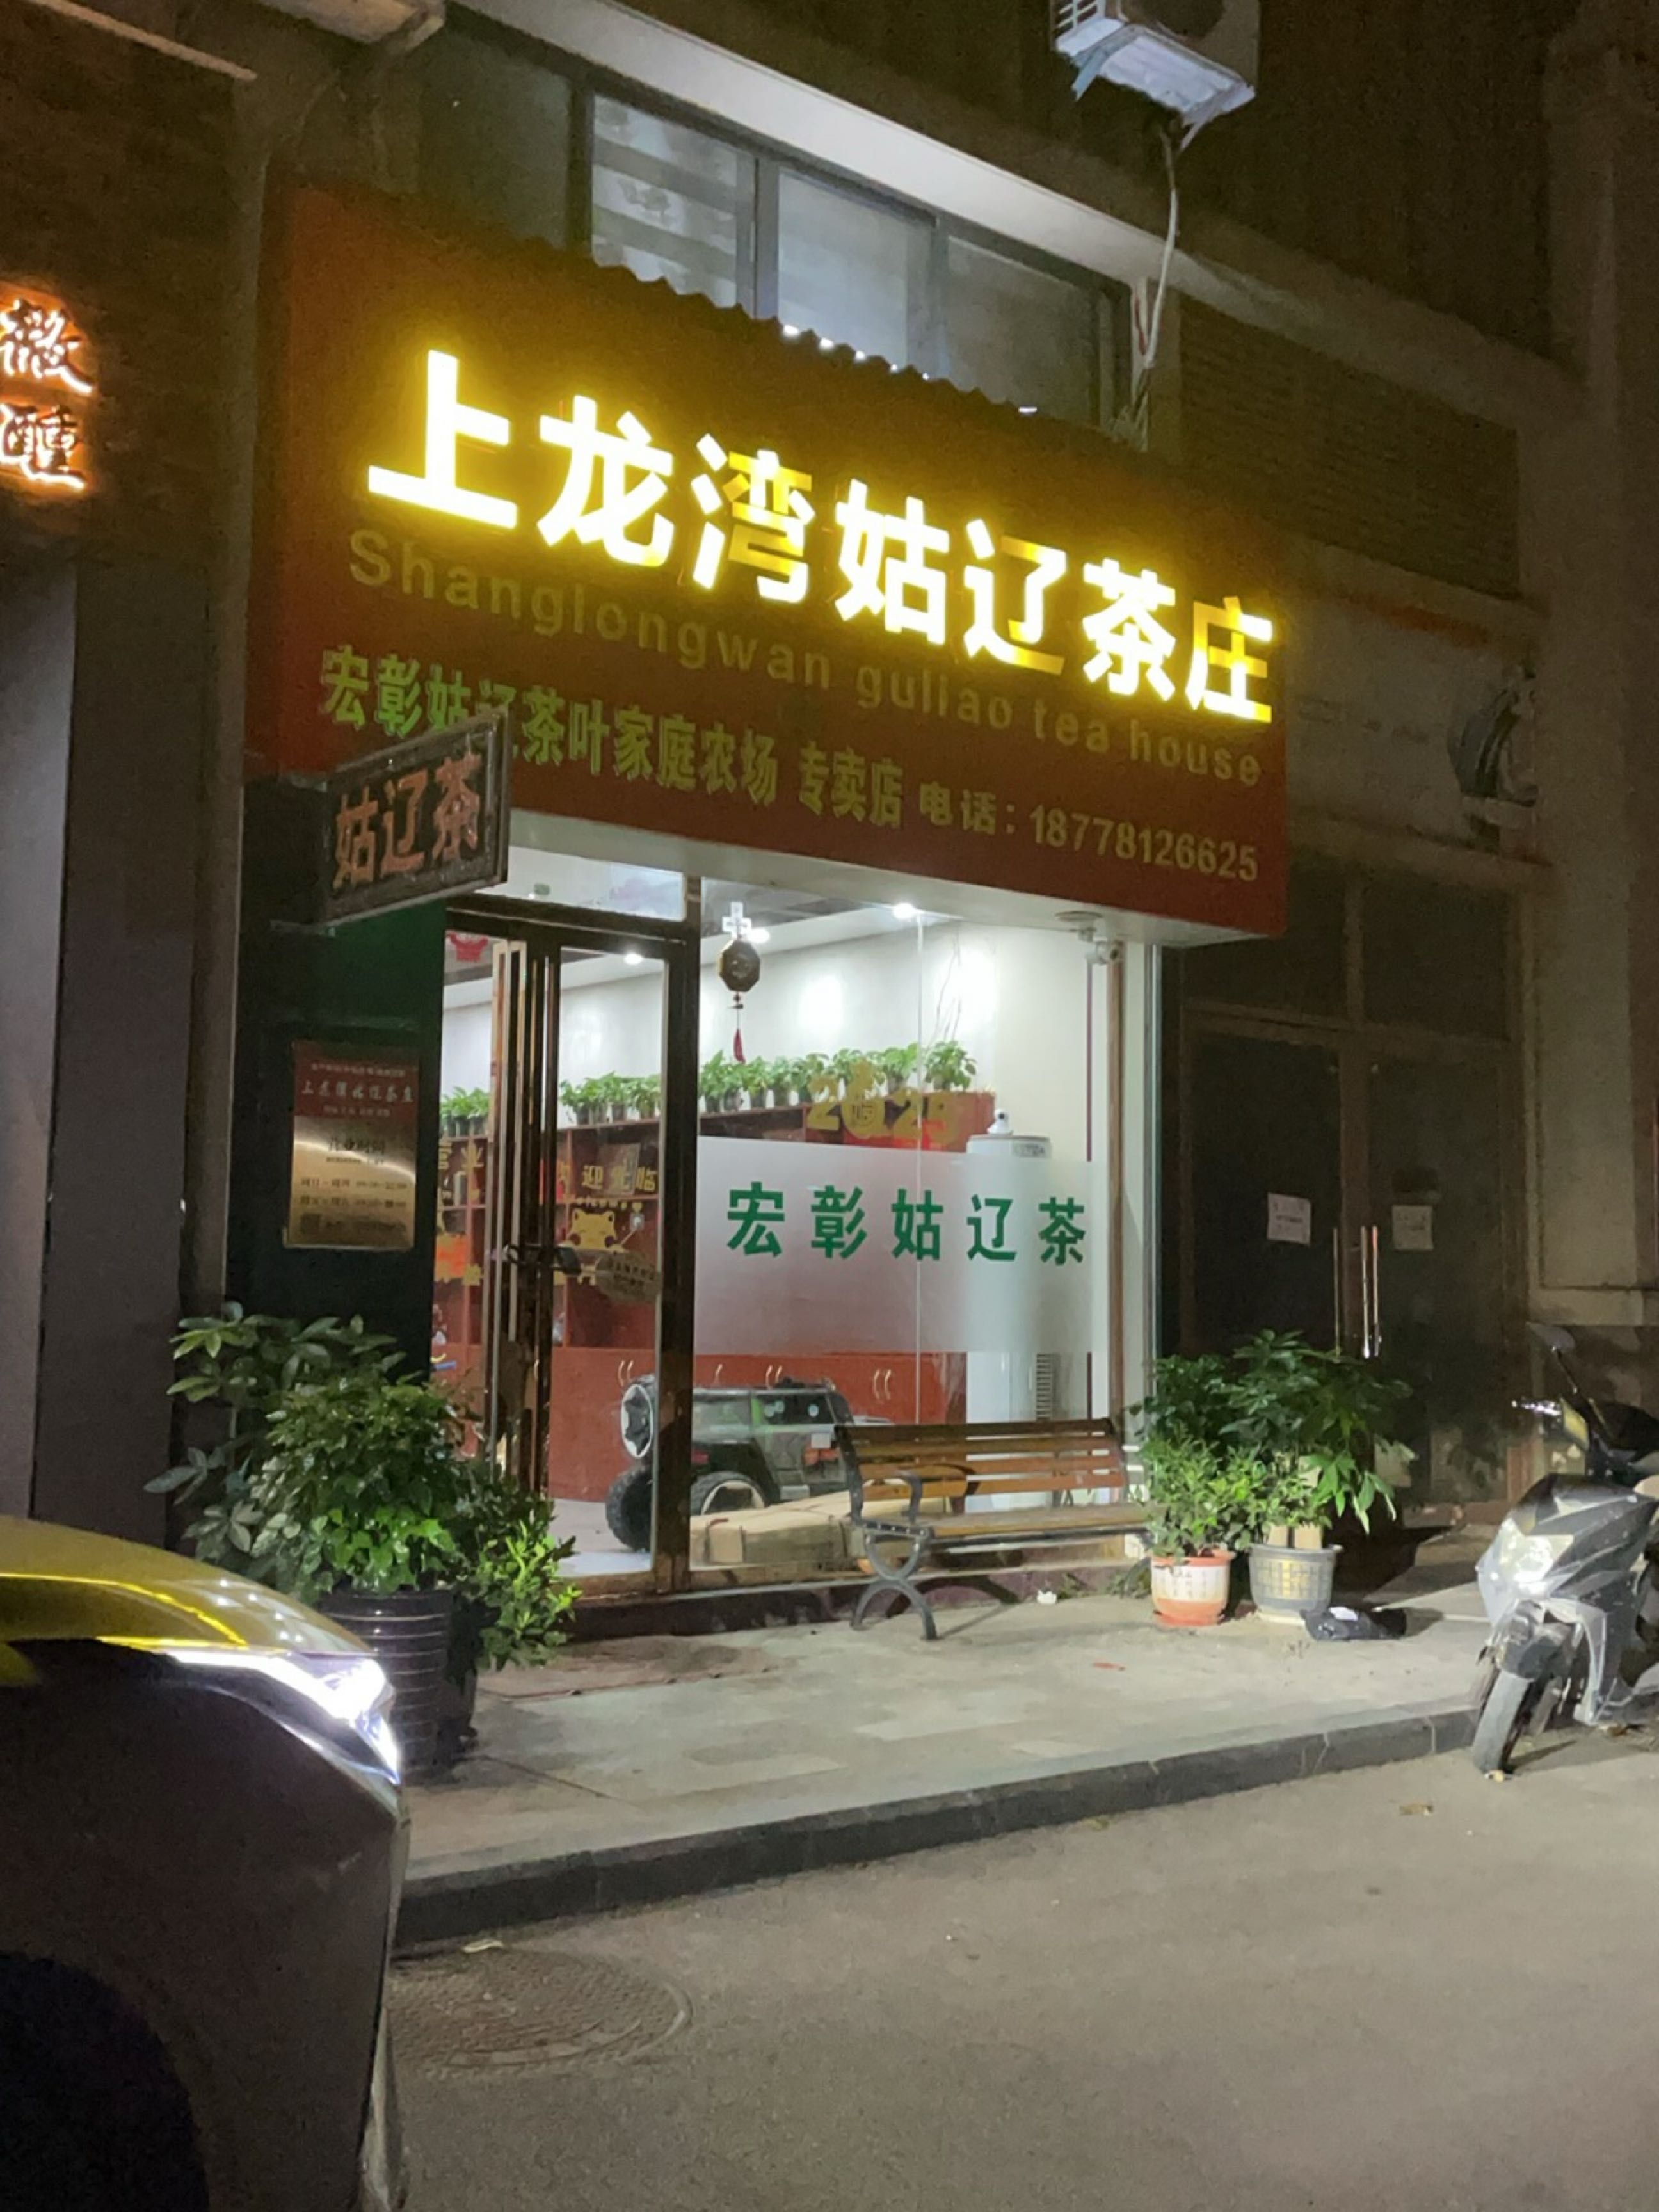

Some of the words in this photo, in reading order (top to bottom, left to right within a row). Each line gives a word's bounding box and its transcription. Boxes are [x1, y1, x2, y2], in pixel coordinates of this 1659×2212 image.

[368, 349, 1272, 725] 上龙湾姑辽茶庄
[349, 529, 831, 689] Shanglongwan
[856, 666, 1013, 730] guliao
[1034, 698, 1110, 753] tea
[1129, 719, 1261, 786] house
[332, 742, 481, 891] 姑辽茶
[799, 741, 903, 830] 专卖店
[1029, 804, 1259, 881] 18778126625
[726, 1181, 1086, 1265] 宏彰姑辽茶
